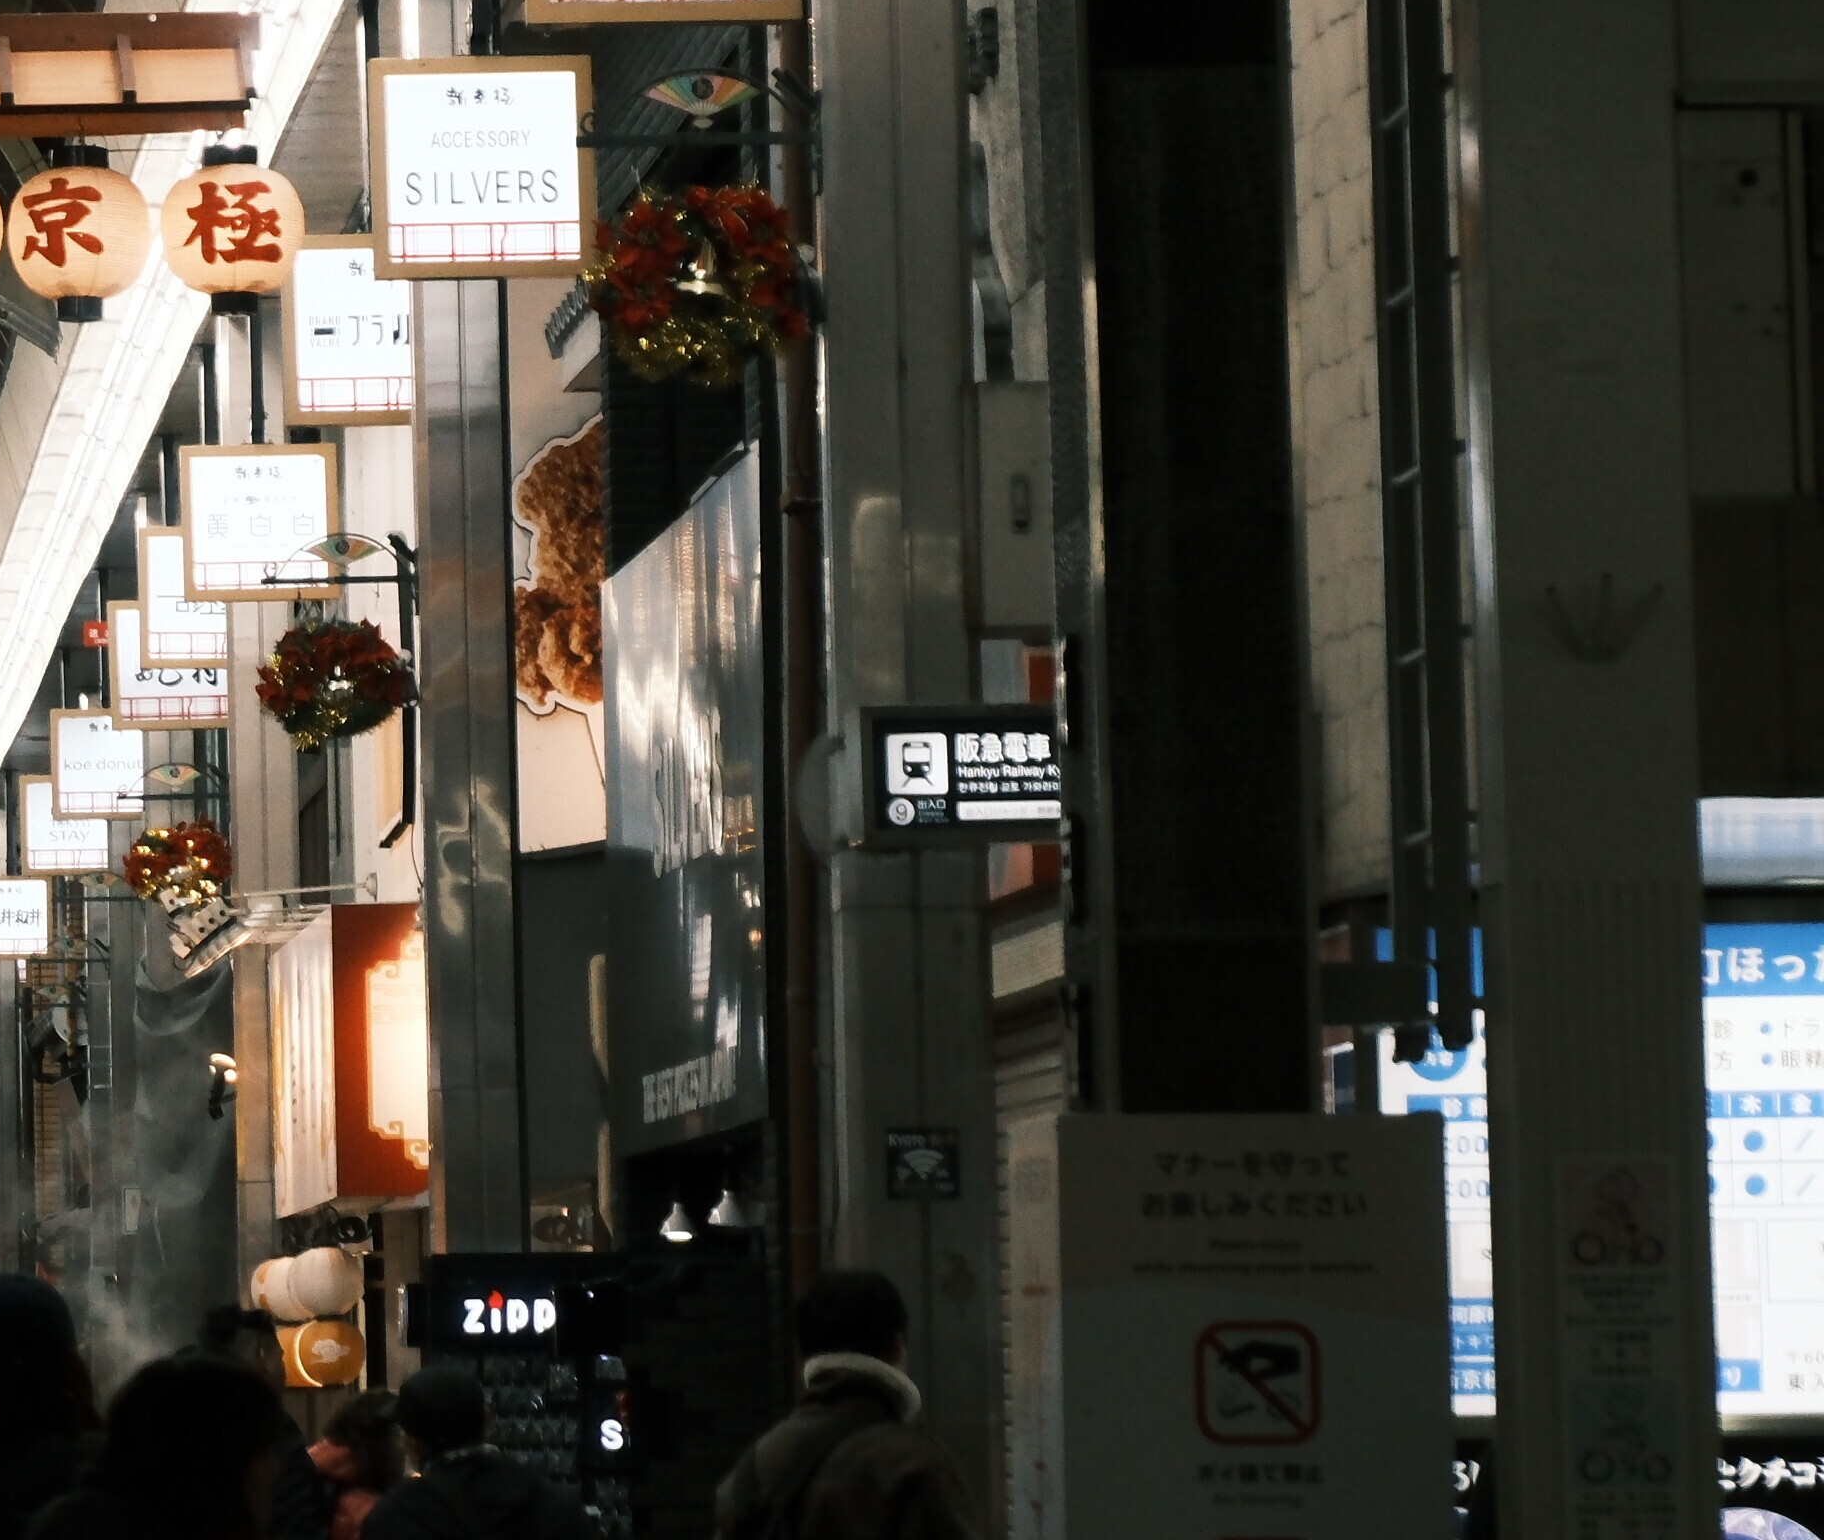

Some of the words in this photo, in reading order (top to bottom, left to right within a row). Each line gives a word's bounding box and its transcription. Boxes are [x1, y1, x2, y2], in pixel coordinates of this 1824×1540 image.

[431, 130, 530, 148] ACCESSORY
[405, 169, 559, 205] SILVERS
[954, 733, 1051, 762] 阪急電車
[64, 759, 92, 771] koe
[958, 765, 1000, 779] Hankyu
[1002, 764, 1047, 779] Railway
[895, 803, 908, 819] 9
